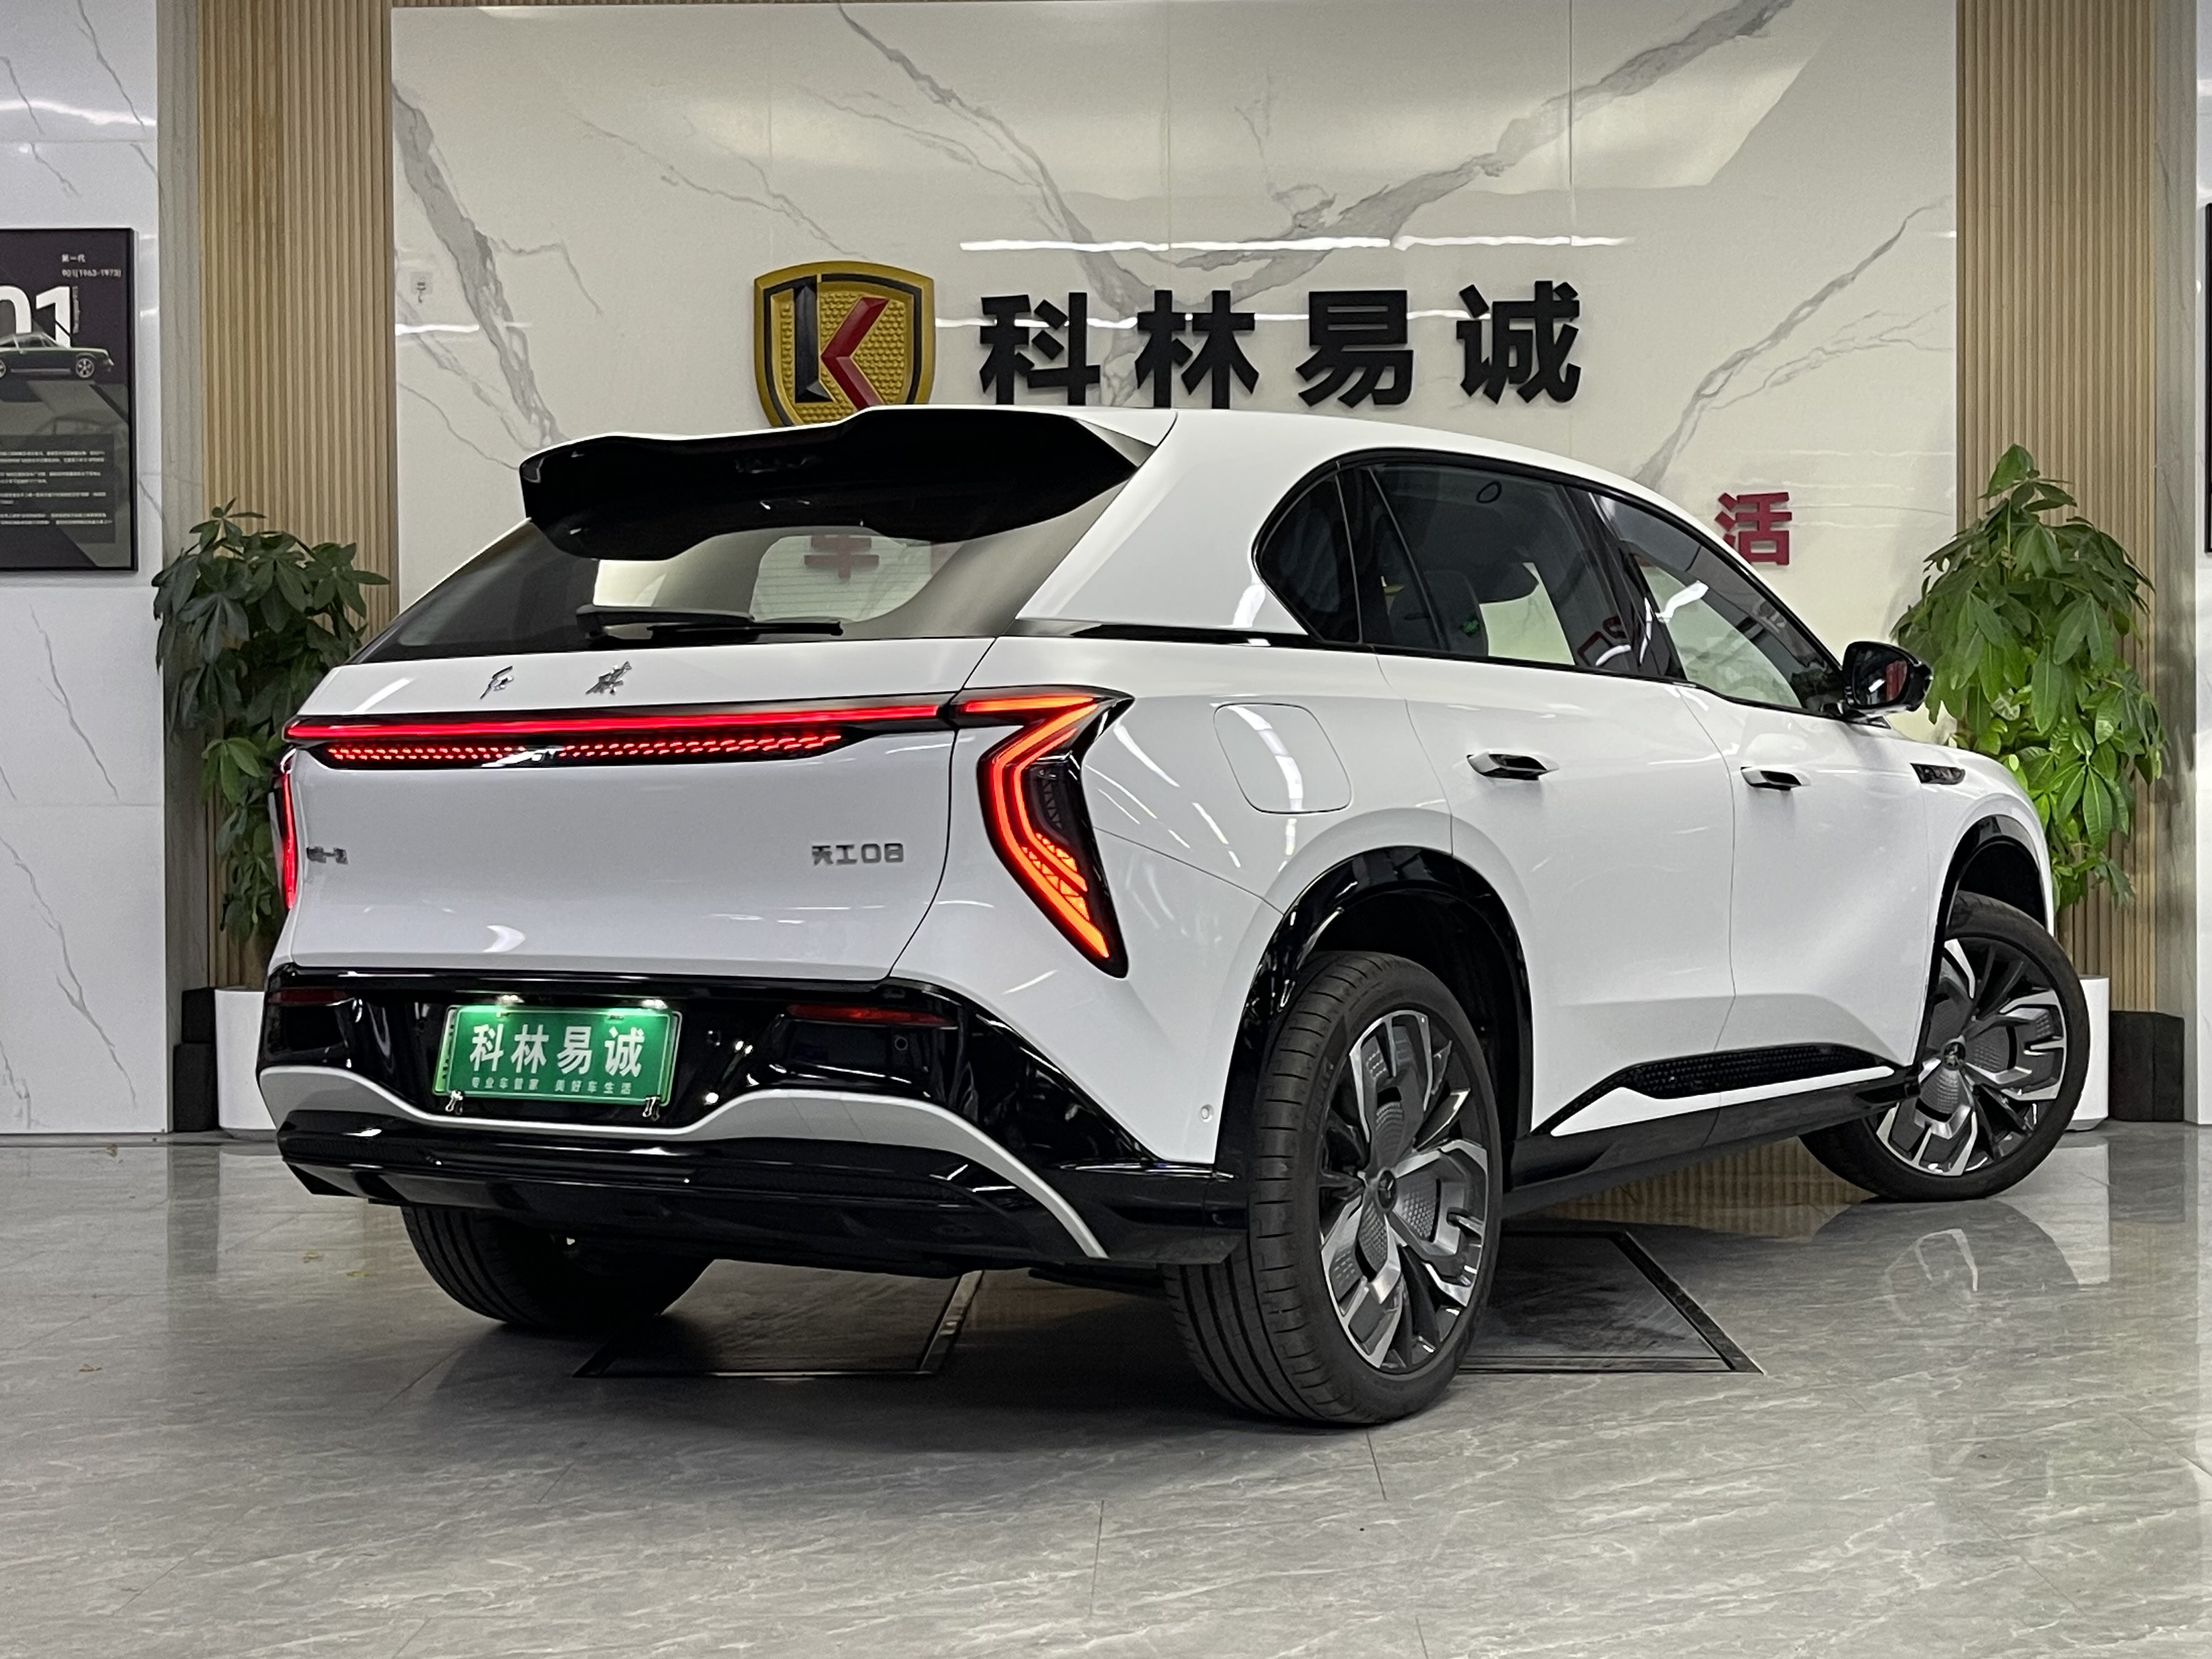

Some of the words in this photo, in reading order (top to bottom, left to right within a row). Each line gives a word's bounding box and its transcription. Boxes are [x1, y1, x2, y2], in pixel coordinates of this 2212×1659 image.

[979, 280, 1582, 409] 科林易诚
[1714, 492, 1792, 566] 活
[469, 1023, 646, 1077] 科林易诚
